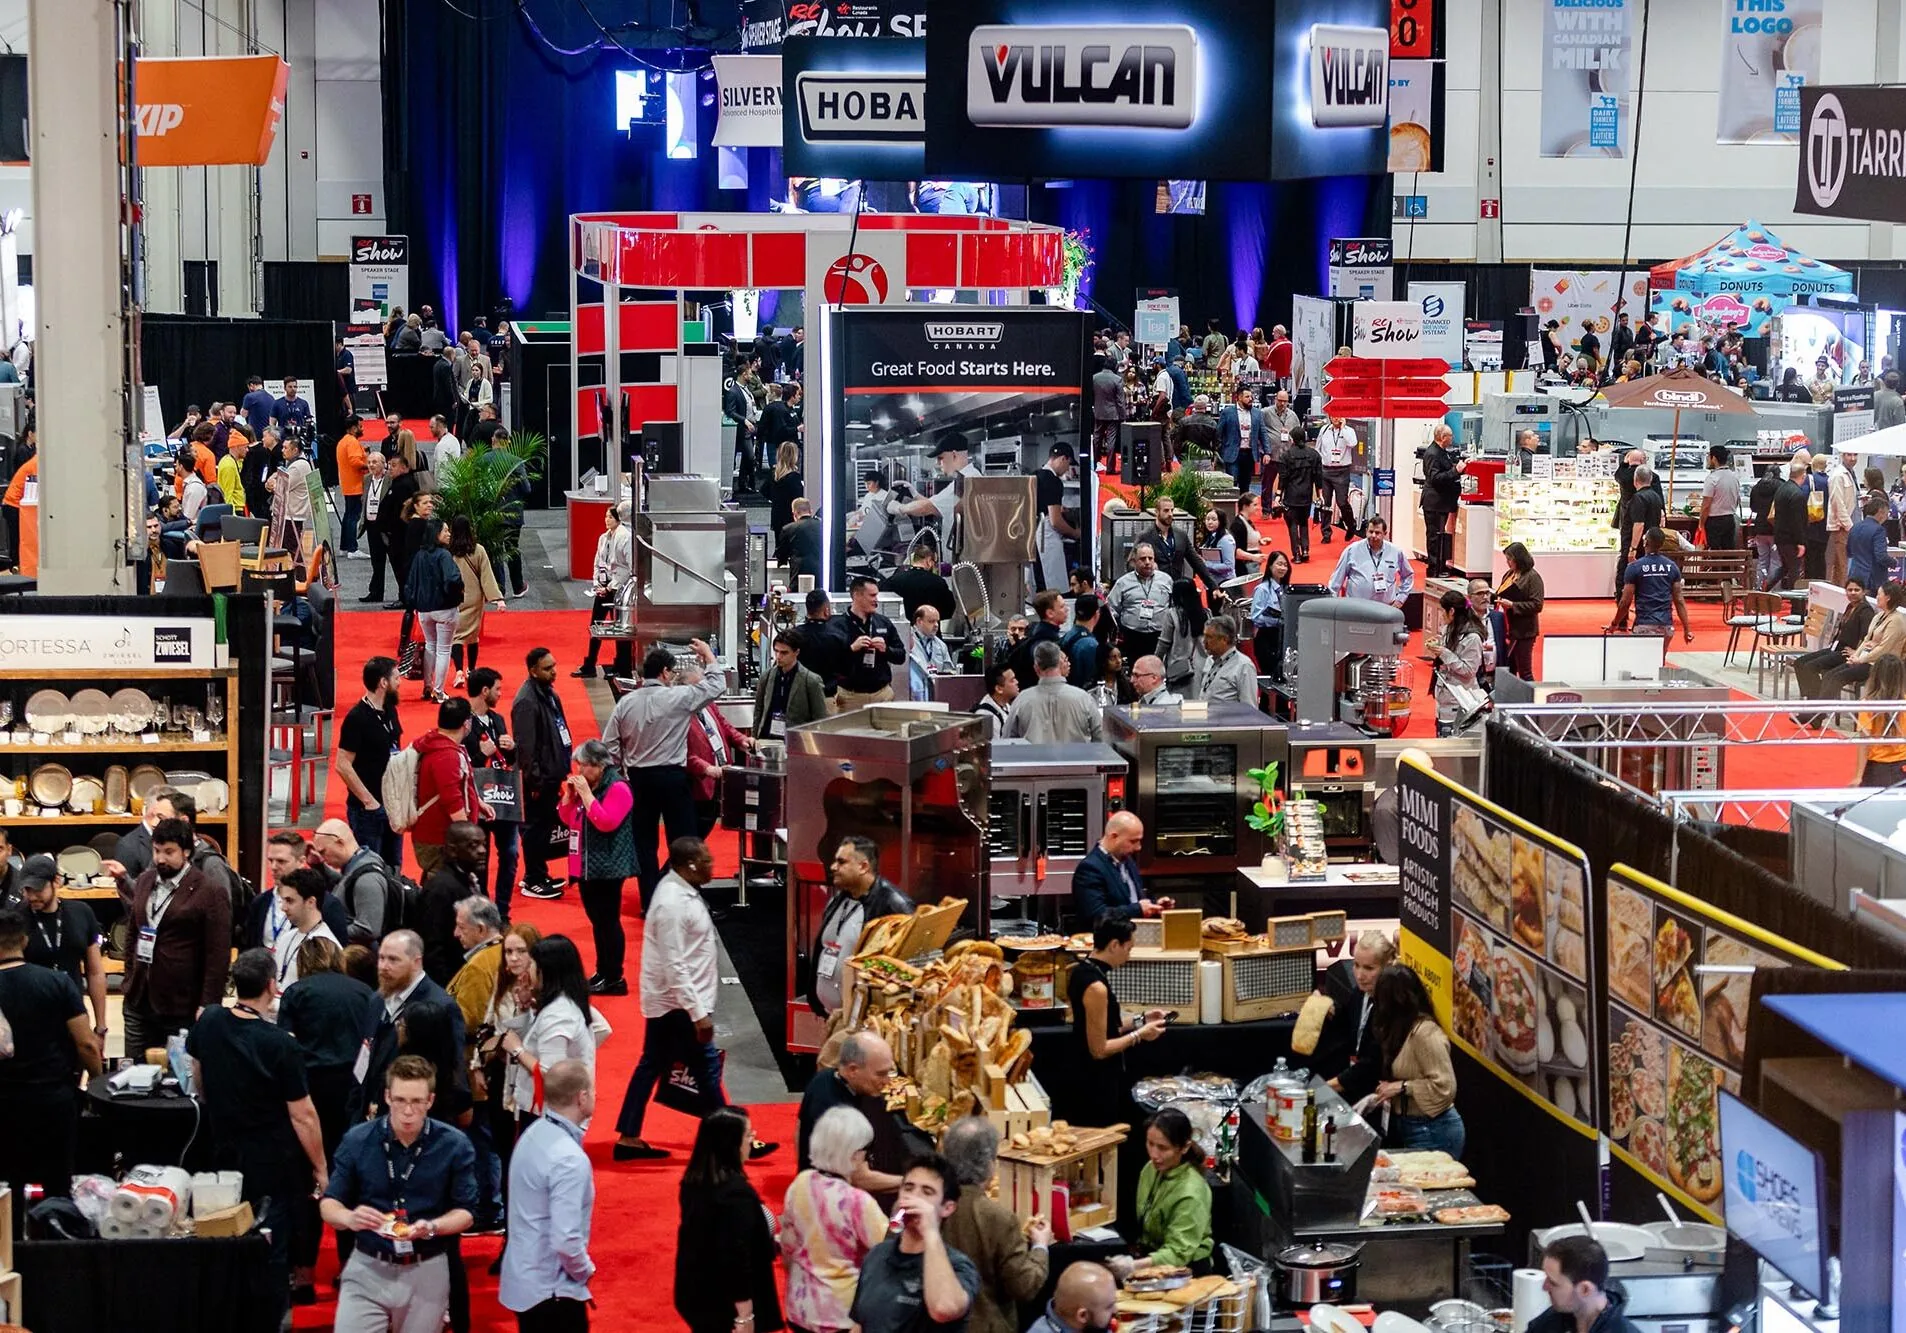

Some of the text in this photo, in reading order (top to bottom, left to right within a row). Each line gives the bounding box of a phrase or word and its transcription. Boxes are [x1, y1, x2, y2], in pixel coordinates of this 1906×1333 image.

[1554, 0, 1624, 8] DELICIOUS
[1737, 0, 1785, 12] THIS
[1554, 11, 1623, 31] WITH
[1731, 17, 1793, 34] LOGO
[1554, 33, 1622, 45] CANADIAN
[1552, 48, 1621, 69] MILK
[981, 45, 1176, 105] VULCAN
[1320, 46, 1384, 105] VULCAN
[1398, 79, 1410, 87] BY
[818, 91, 926, 120] HOBA
[356, 241, 404, 262] Show
[1344, 244, 1390, 265] Show
[1719, 281, 1835, 293] DONUTS DONUTS
[934, 326, 997, 336] HOBART
[1370, 320, 1420, 344] Show
[1371, 318, 1388, 327] RC
[871, 360, 1056, 377] Great Food Starts Here.
[1661, 390, 1700, 402] bindi
[155, 641, 192, 657] ZWIESEL
[483, 784, 515, 801] Show
[1401, 783, 1439, 833] MIMI
[1401, 816, 1440, 860] FOODS
[1403, 856, 1439, 893] ARTISTIC
[1403, 876, 1439, 913] DOUGH
[1403, 895, 1440, 931] PRODUCTS
[1756, 1160, 1801, 1208] SHOES
